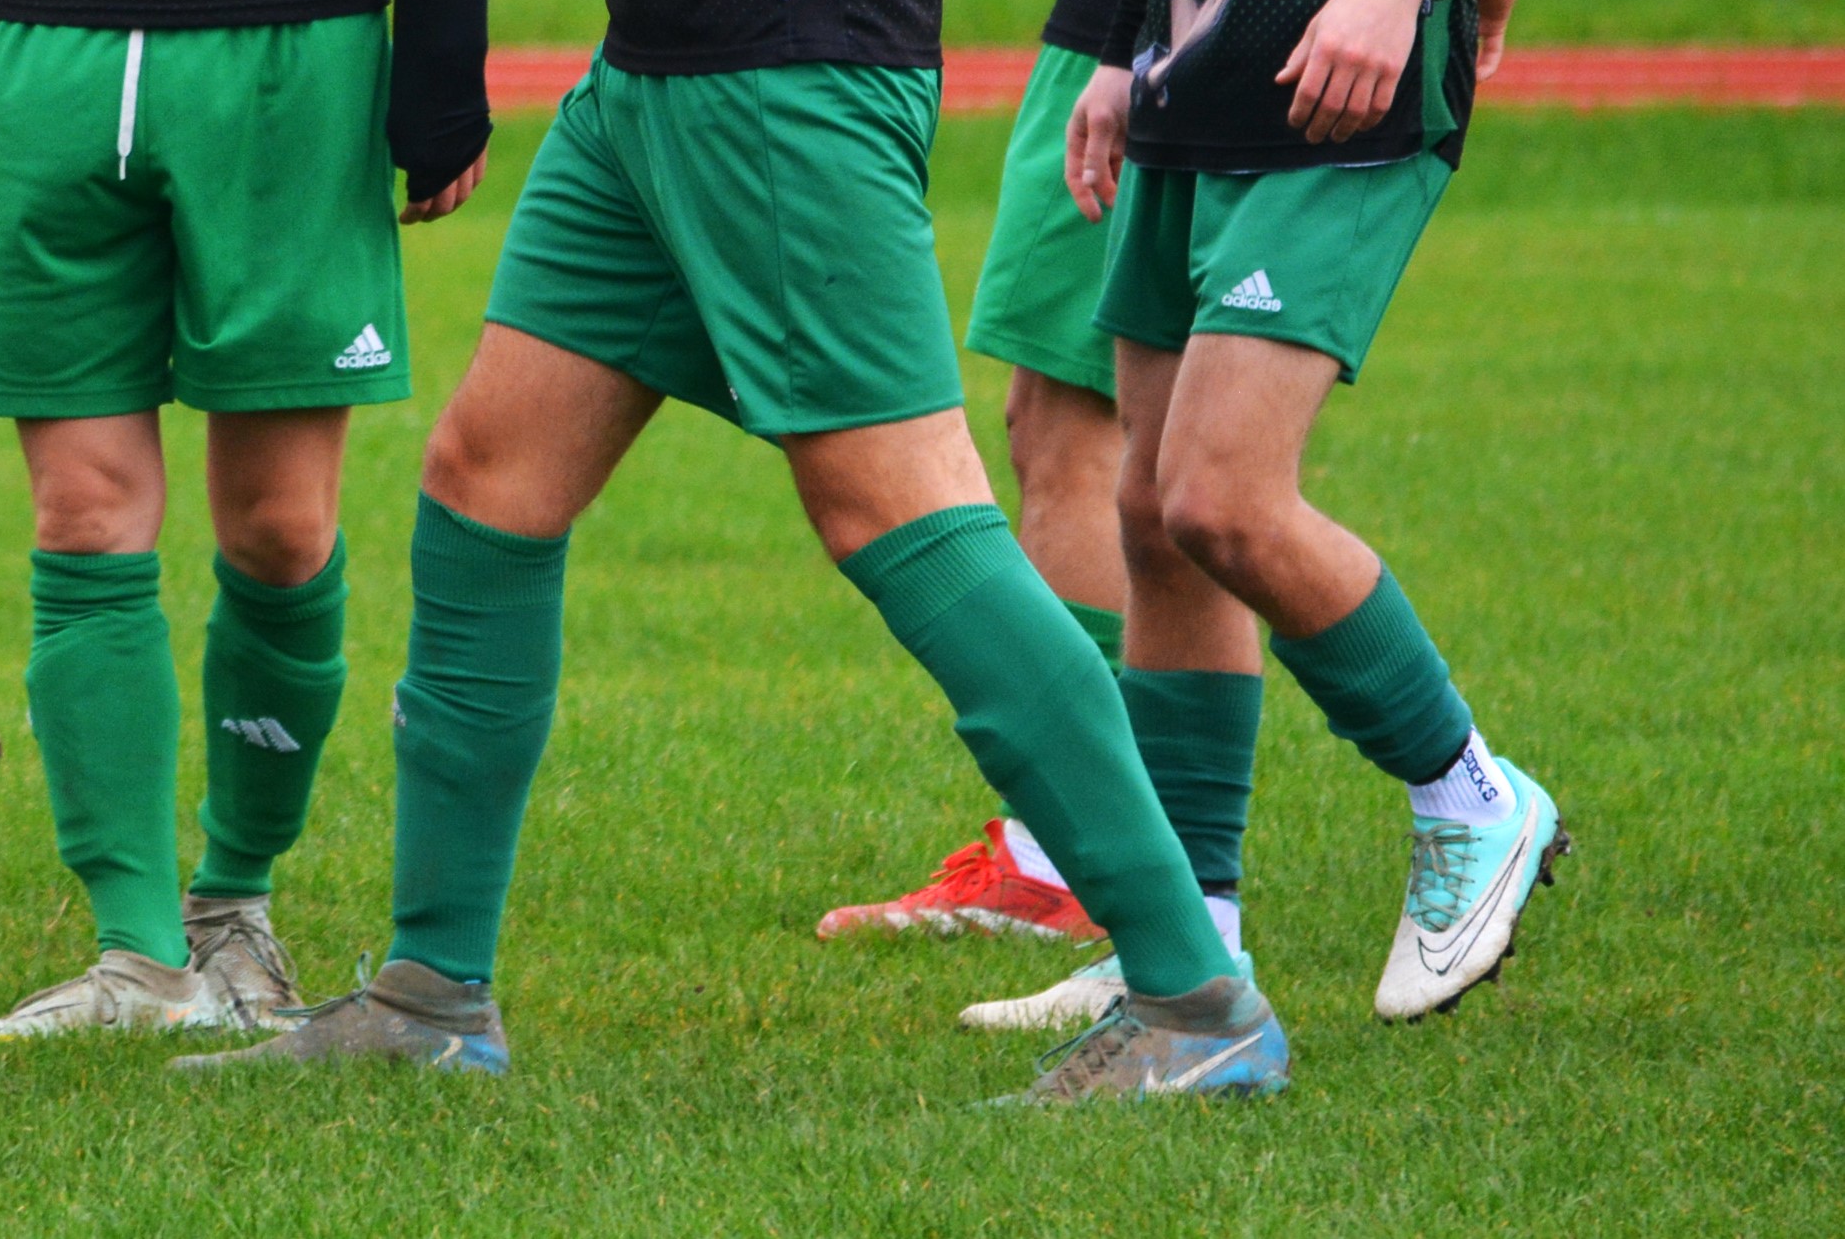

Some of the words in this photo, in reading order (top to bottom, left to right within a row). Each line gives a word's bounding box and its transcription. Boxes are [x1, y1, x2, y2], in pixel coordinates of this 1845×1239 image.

[1221, 293, 1282, 313] adidas
[335, 350, 392, 369] adidas
[1462, 748, 1499, 803] SOCKS
